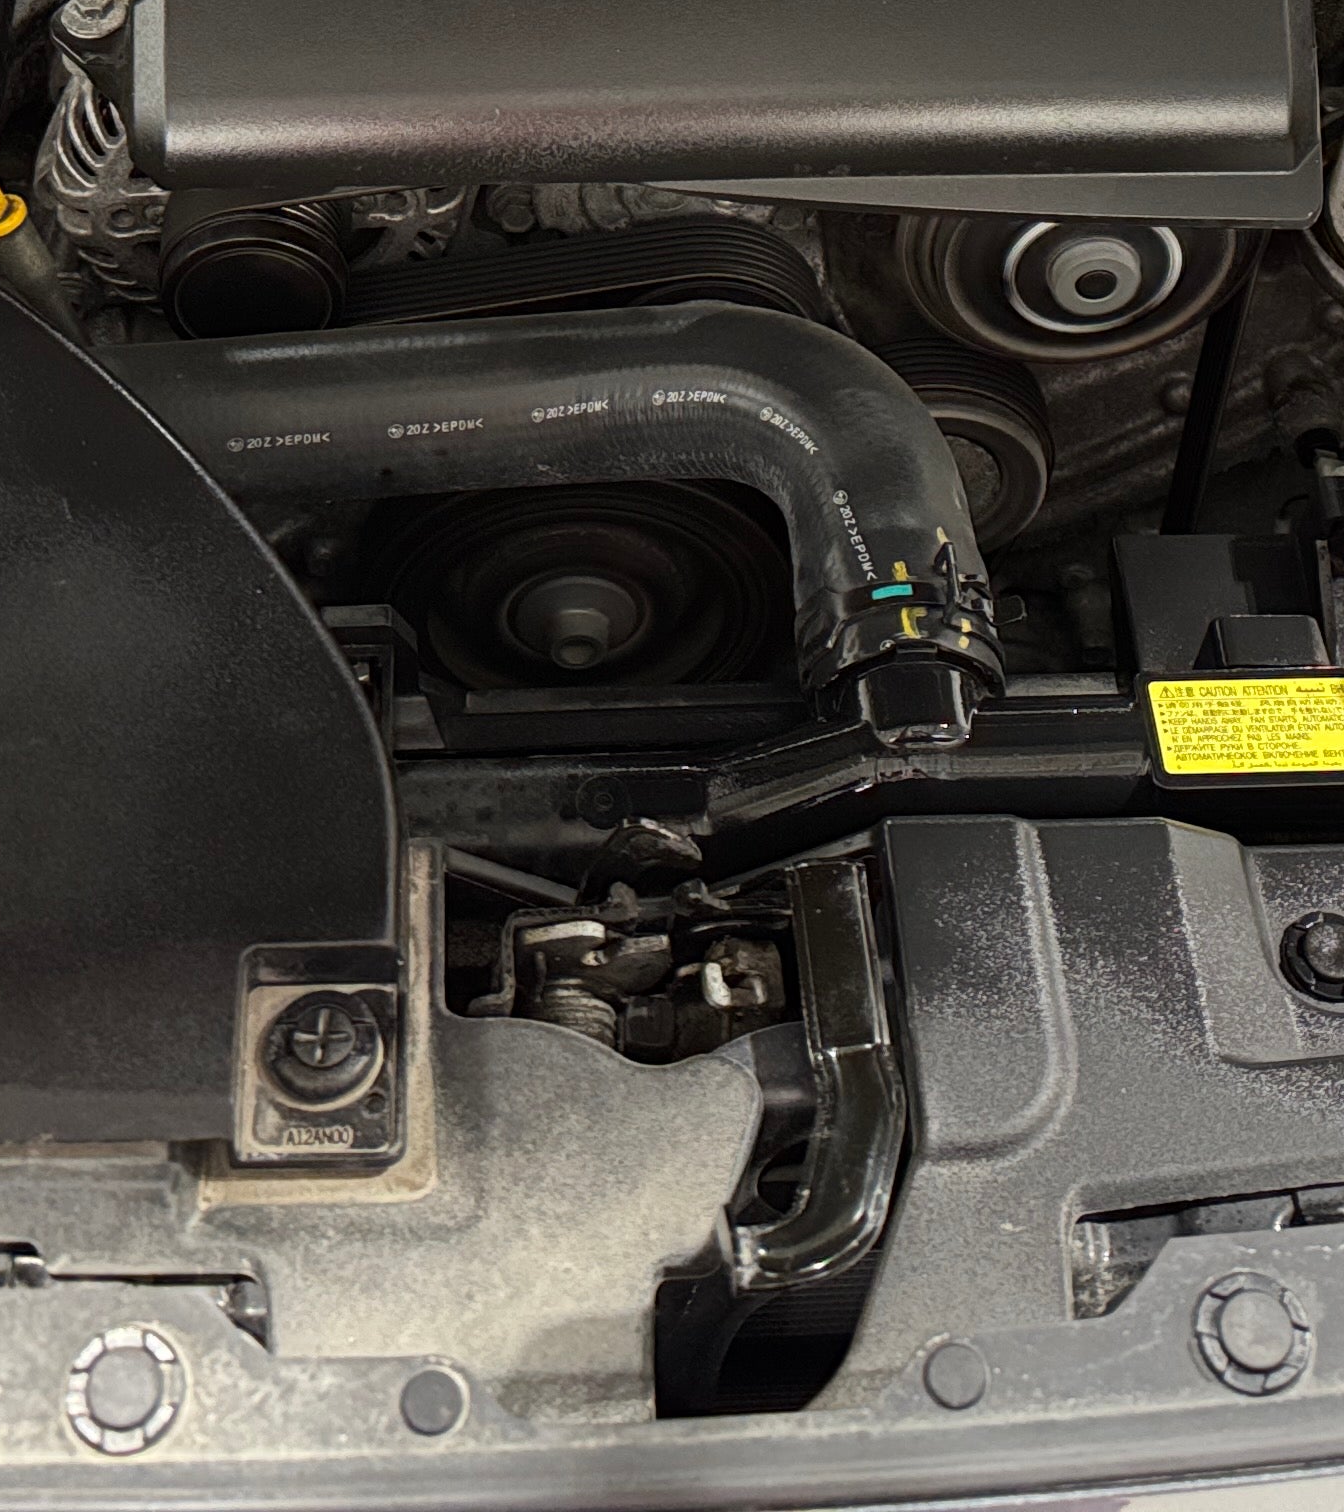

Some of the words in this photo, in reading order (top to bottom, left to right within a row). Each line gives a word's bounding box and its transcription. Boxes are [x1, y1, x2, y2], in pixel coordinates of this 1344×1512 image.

[1198, 686, 1237, 697] CAUTION
[1242, 684, 1289, 696] ATTENTION
[1167, 717, 1187, 725] KEEP
[1268, 715, 1297, 724] STARTS
[1169, 727, 1181, 735] LE
[1267, 733, 1280, 741] LES
